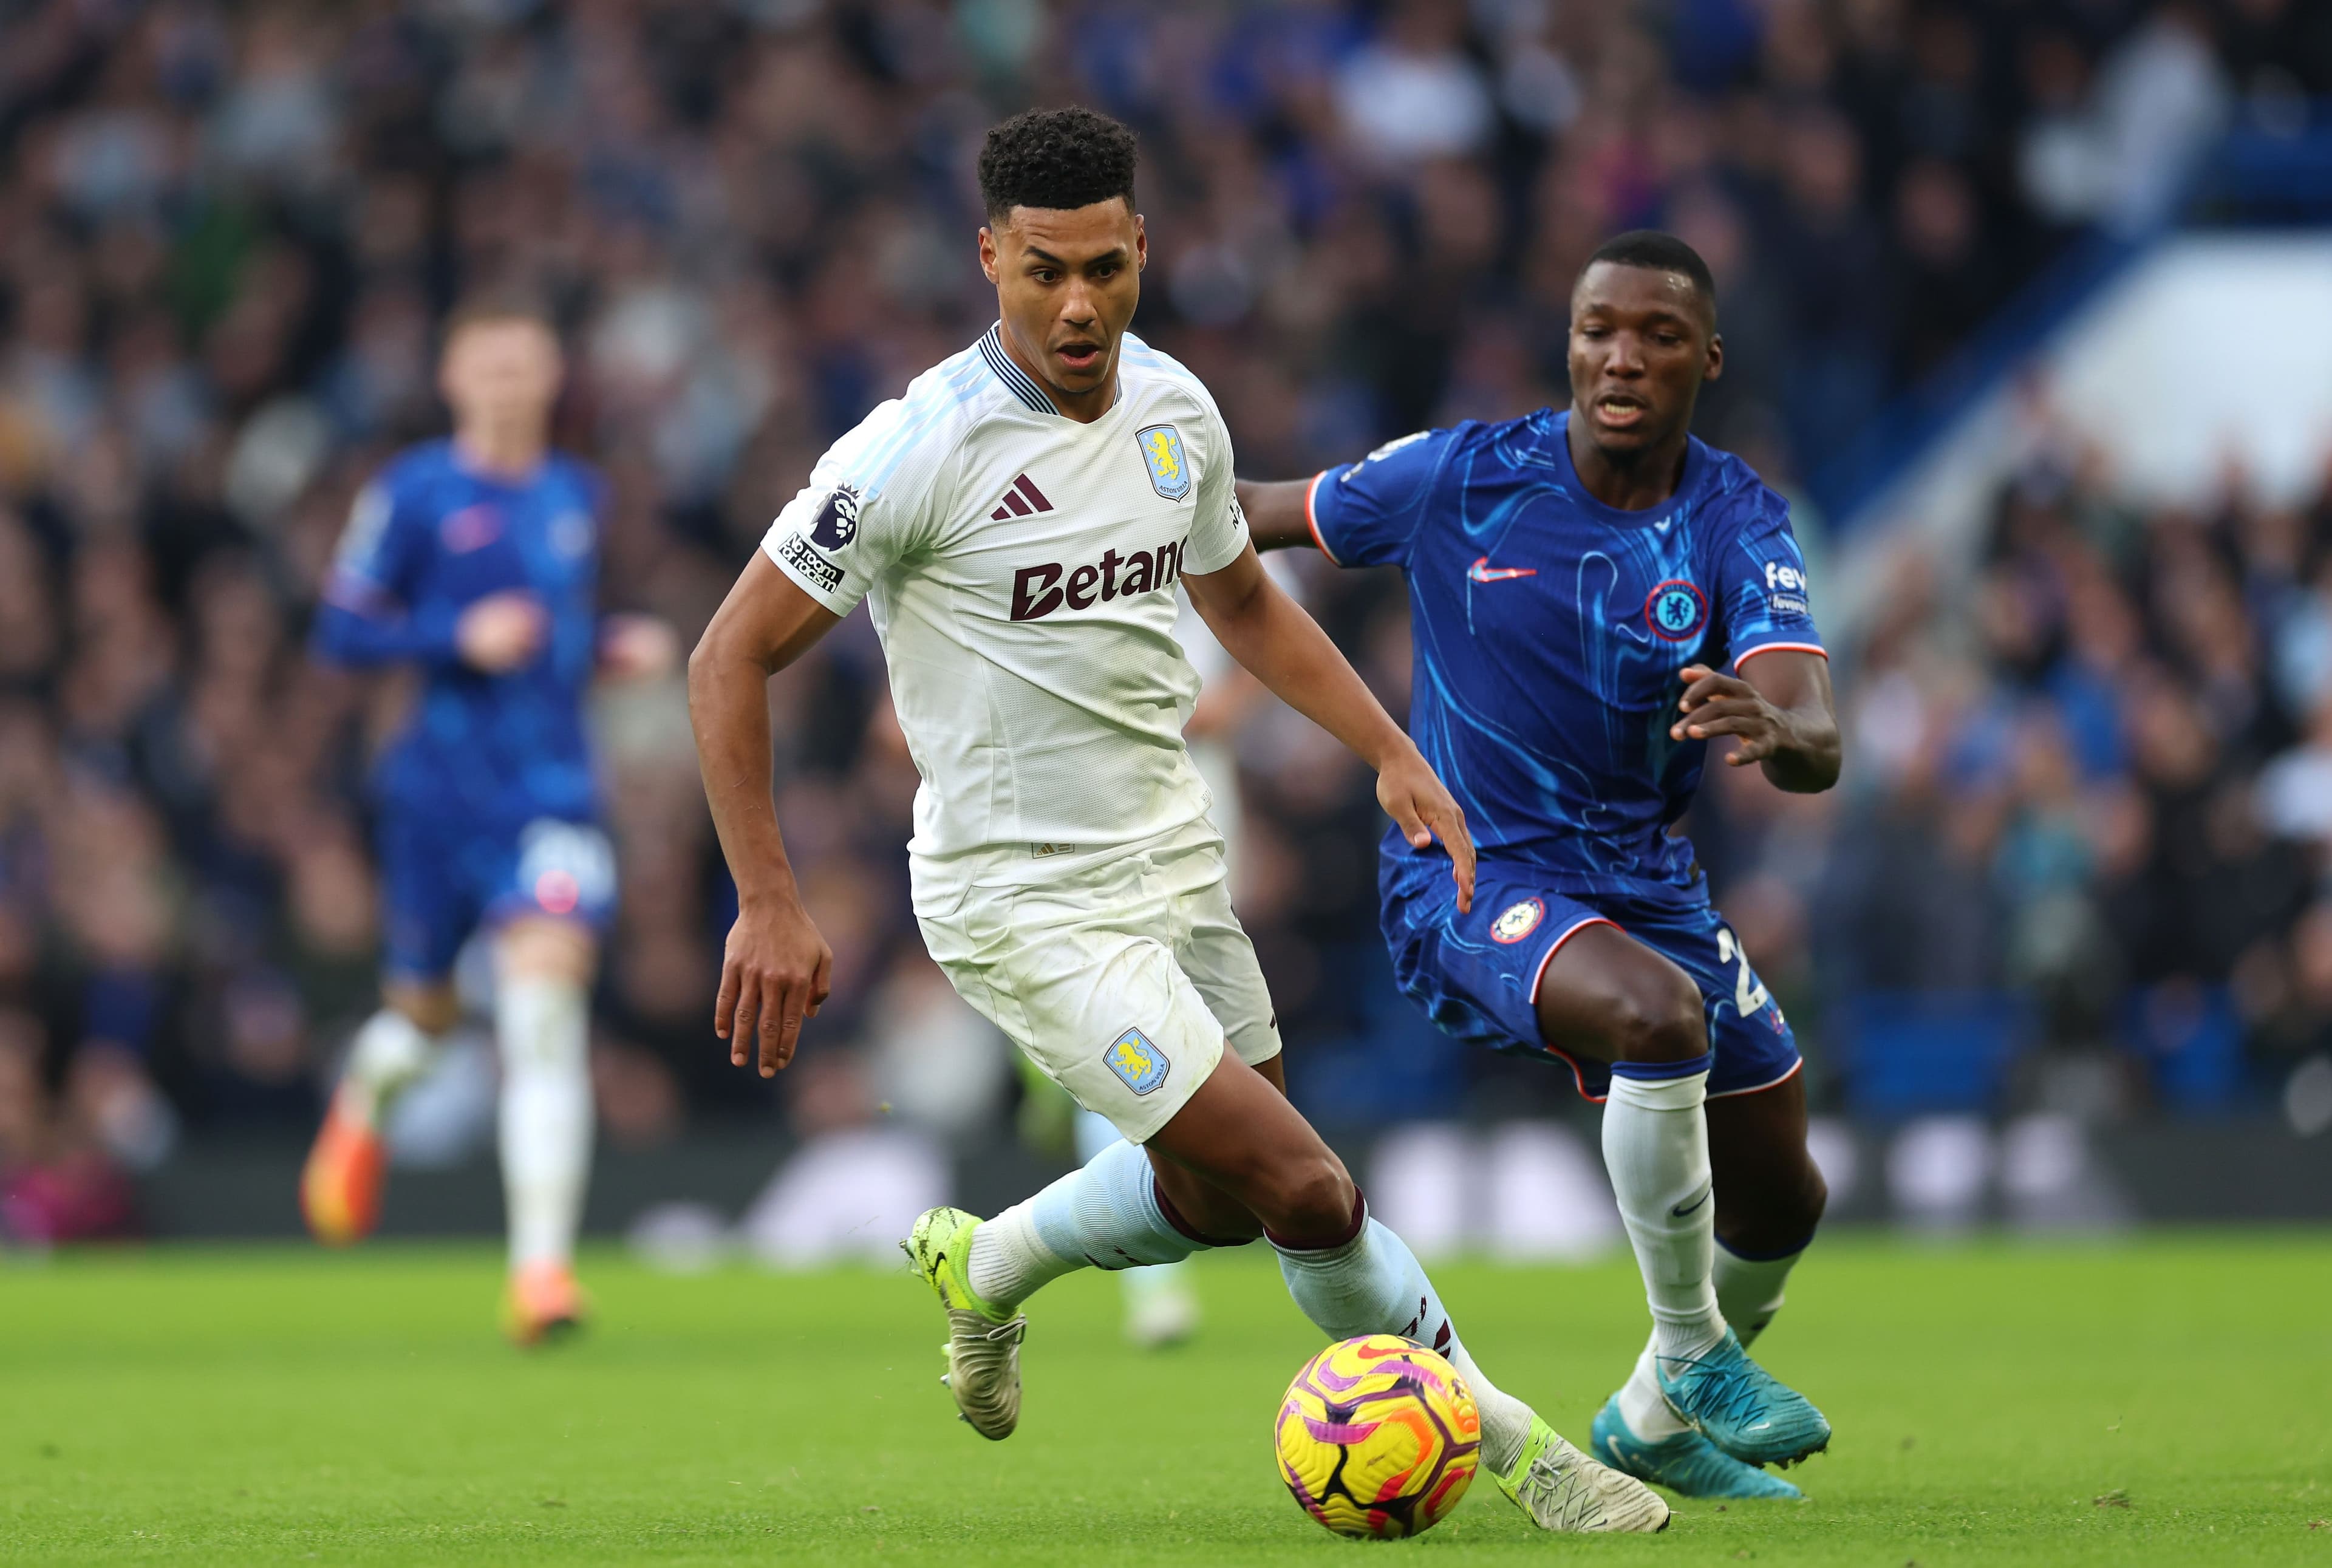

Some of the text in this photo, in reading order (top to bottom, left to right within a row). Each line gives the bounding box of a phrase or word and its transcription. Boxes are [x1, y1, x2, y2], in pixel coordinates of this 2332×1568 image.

[1159, 485, 1177, 494] ASTON
[1176, 480, 1188, 493] VILLA
[778, 540, 837, 593] for racism
[787, 531, 837, 579] No room
[1716, 927, 1768, 1018] 2
[1139, 1079, 1157, 1091] ASTON
[1155, 1063, 1165, 1080] VILLA
